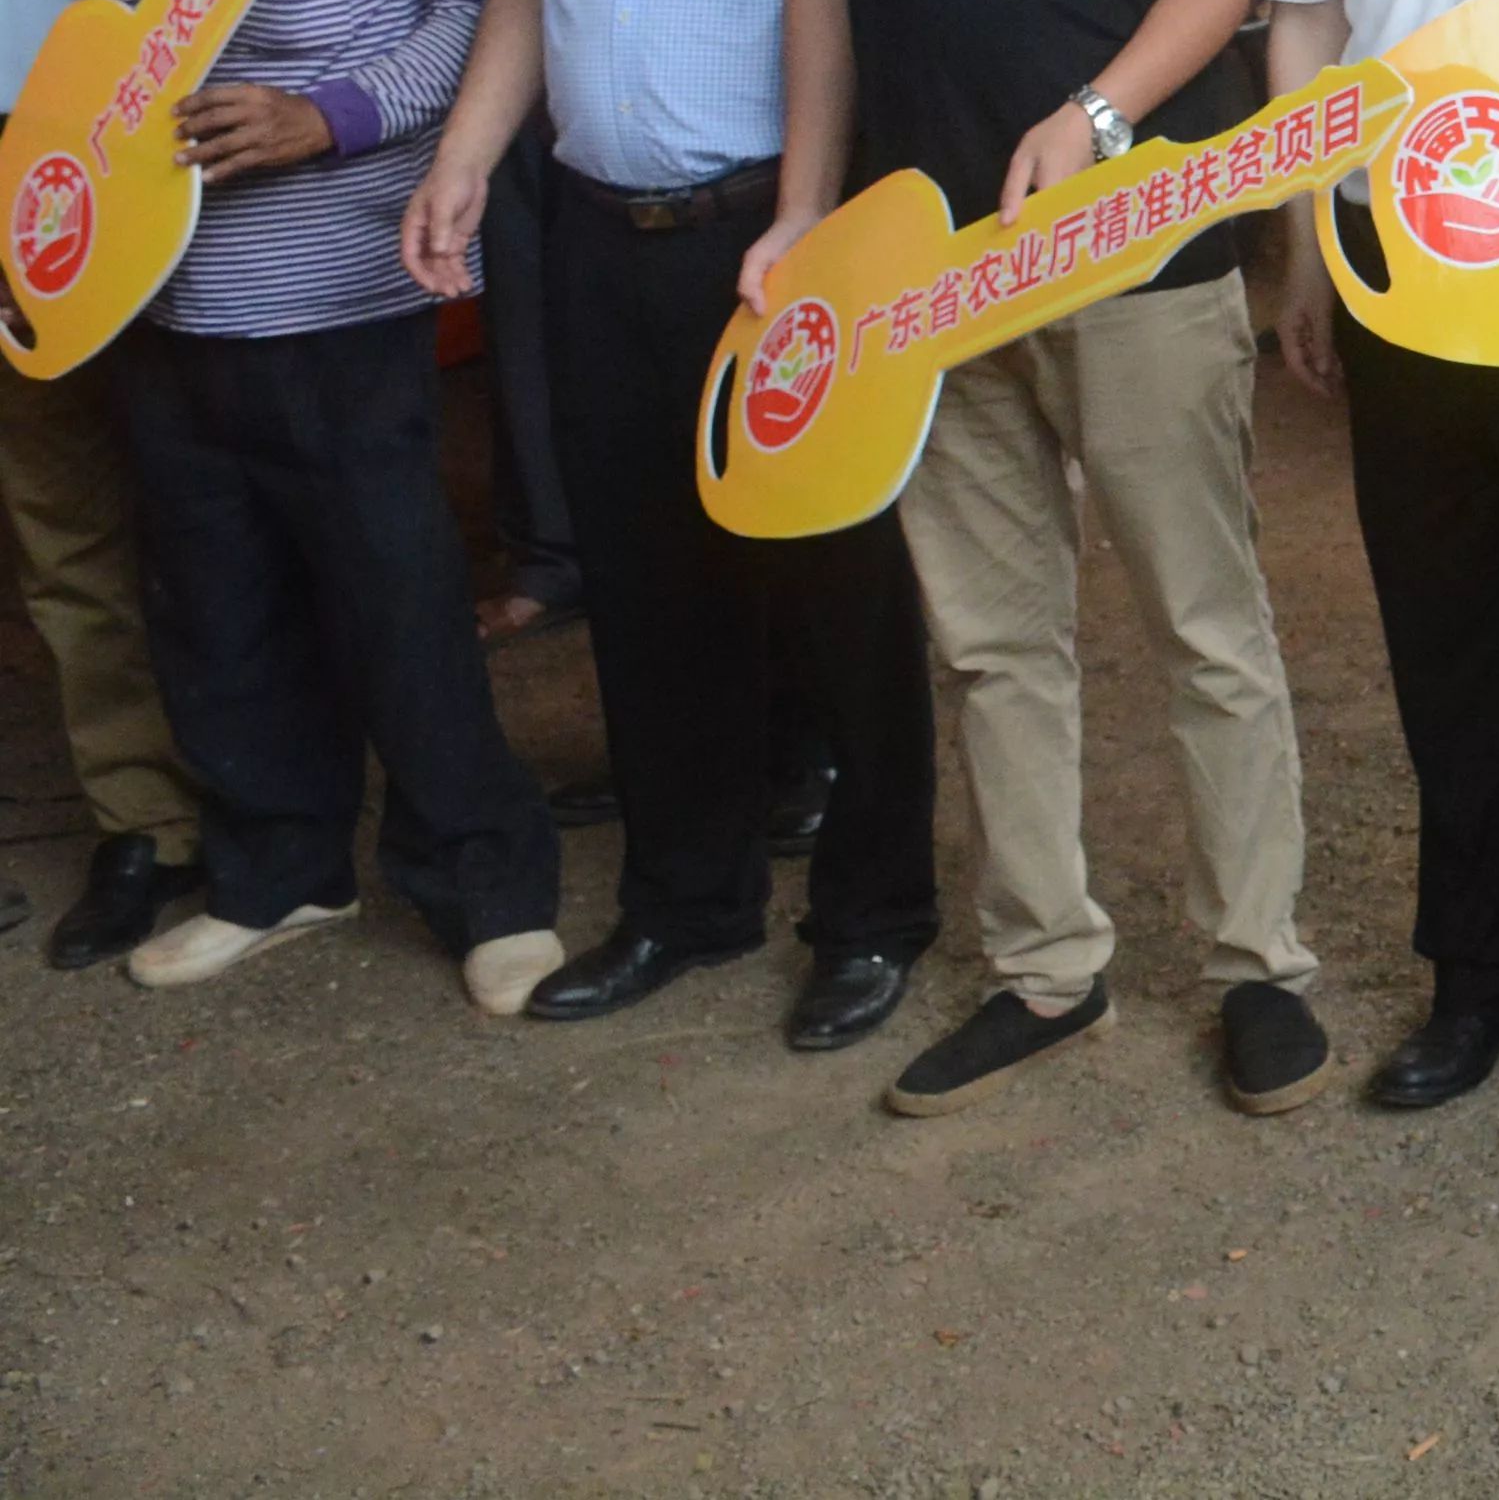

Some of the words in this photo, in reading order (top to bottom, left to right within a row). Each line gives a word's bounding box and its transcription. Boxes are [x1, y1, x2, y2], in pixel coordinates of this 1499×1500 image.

[848, 84, 1363, 374] 广东省农业厅精准扶贫项目
